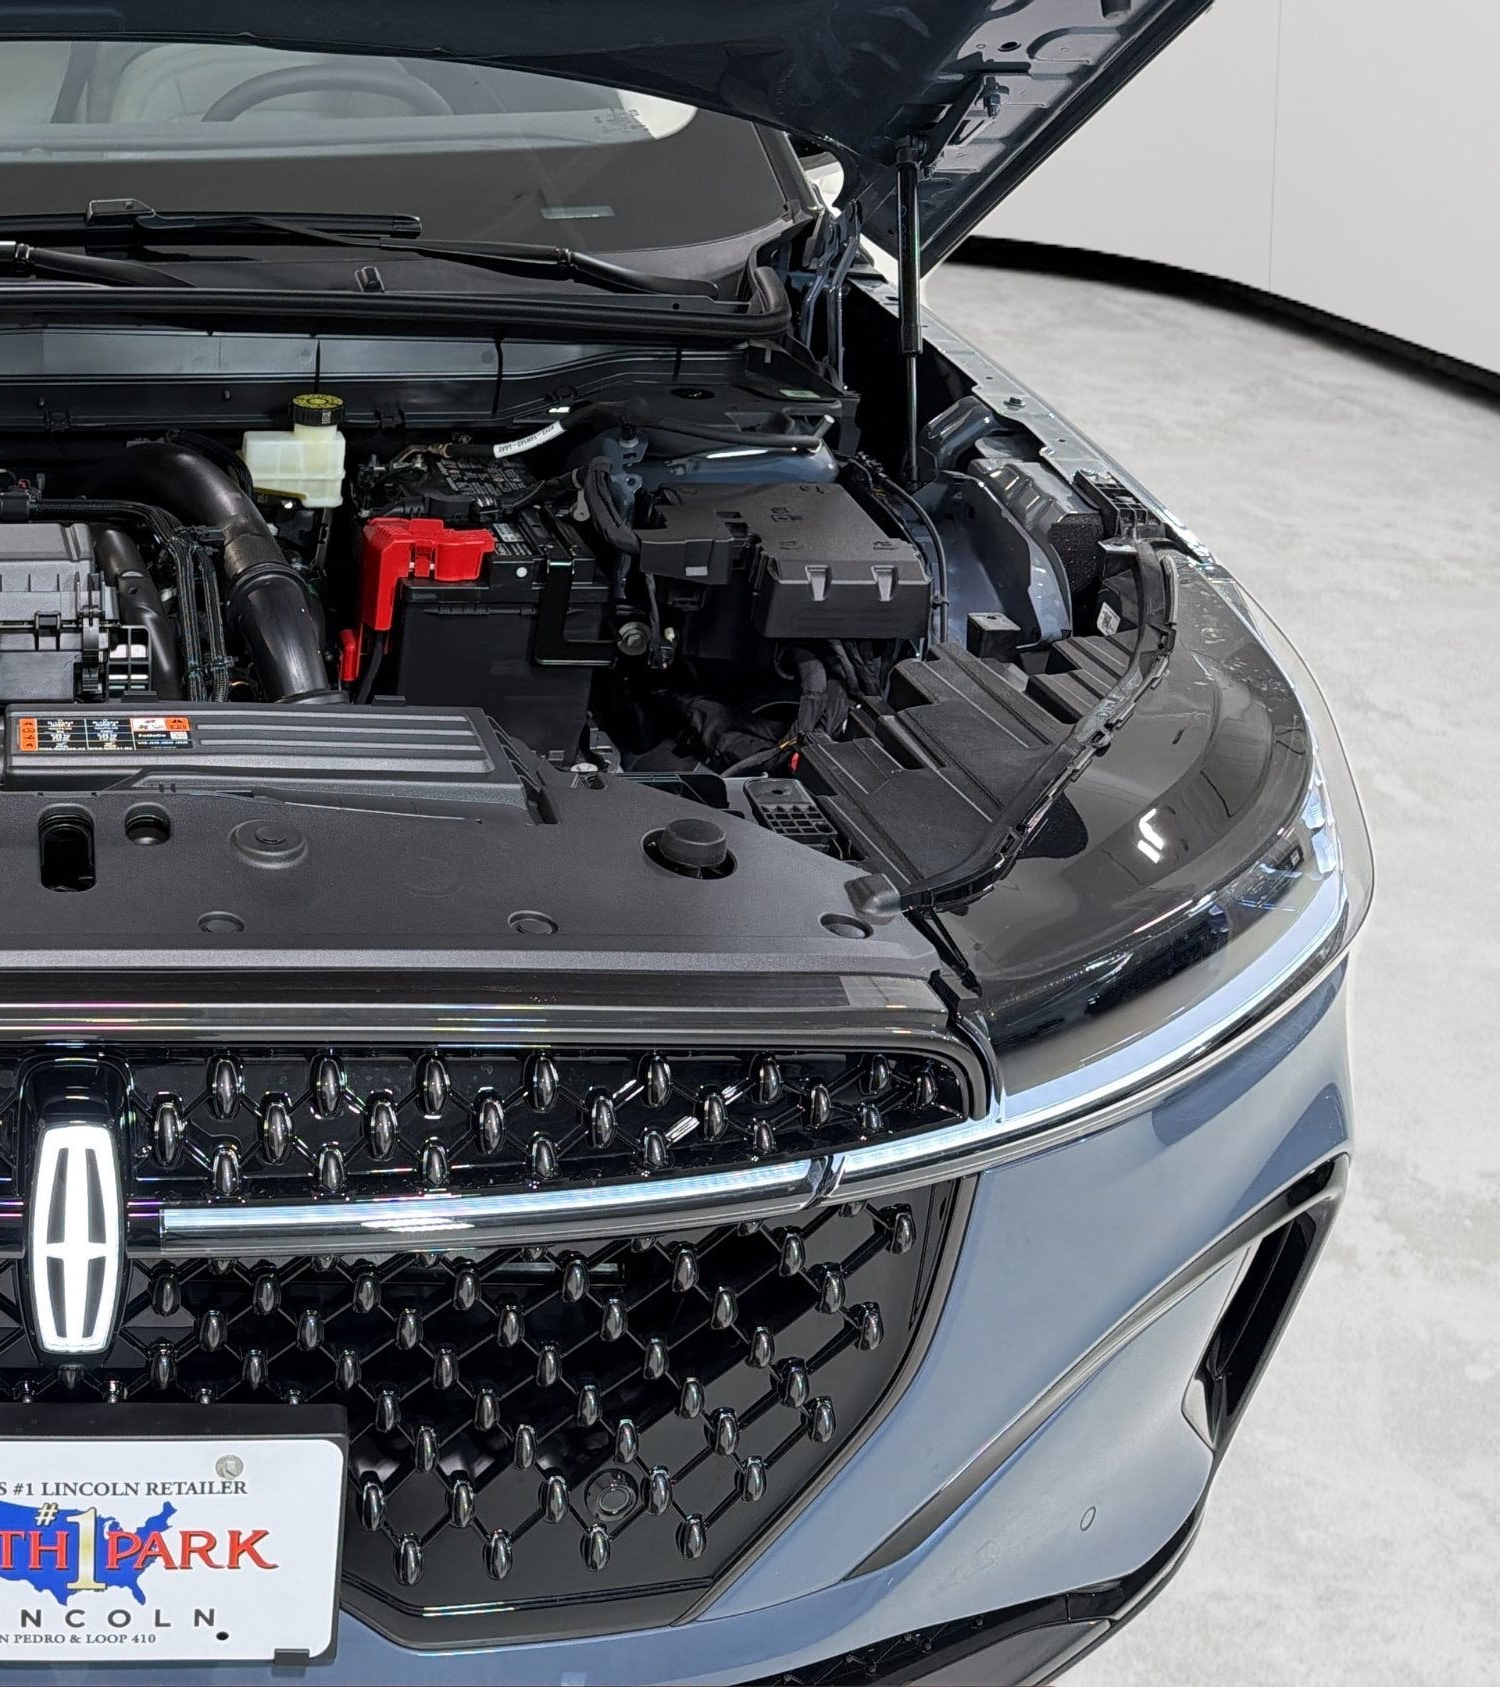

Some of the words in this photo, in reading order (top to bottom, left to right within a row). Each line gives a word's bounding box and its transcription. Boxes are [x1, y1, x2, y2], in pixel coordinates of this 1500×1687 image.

[13, 1483, 35, 1496] #1
[41, 1481, 140, 1497] LINCOLN
[145, 1479, 248, 1496] RETAILER
[106, 1528, 279, 1571] PARK
[13, 1634, 65, 1644] PEDRO
[70, 1634, 82, 1644] &
[86, 1634, 128, 1644] LOOP
[131, 1634, 156, 1644] 410
